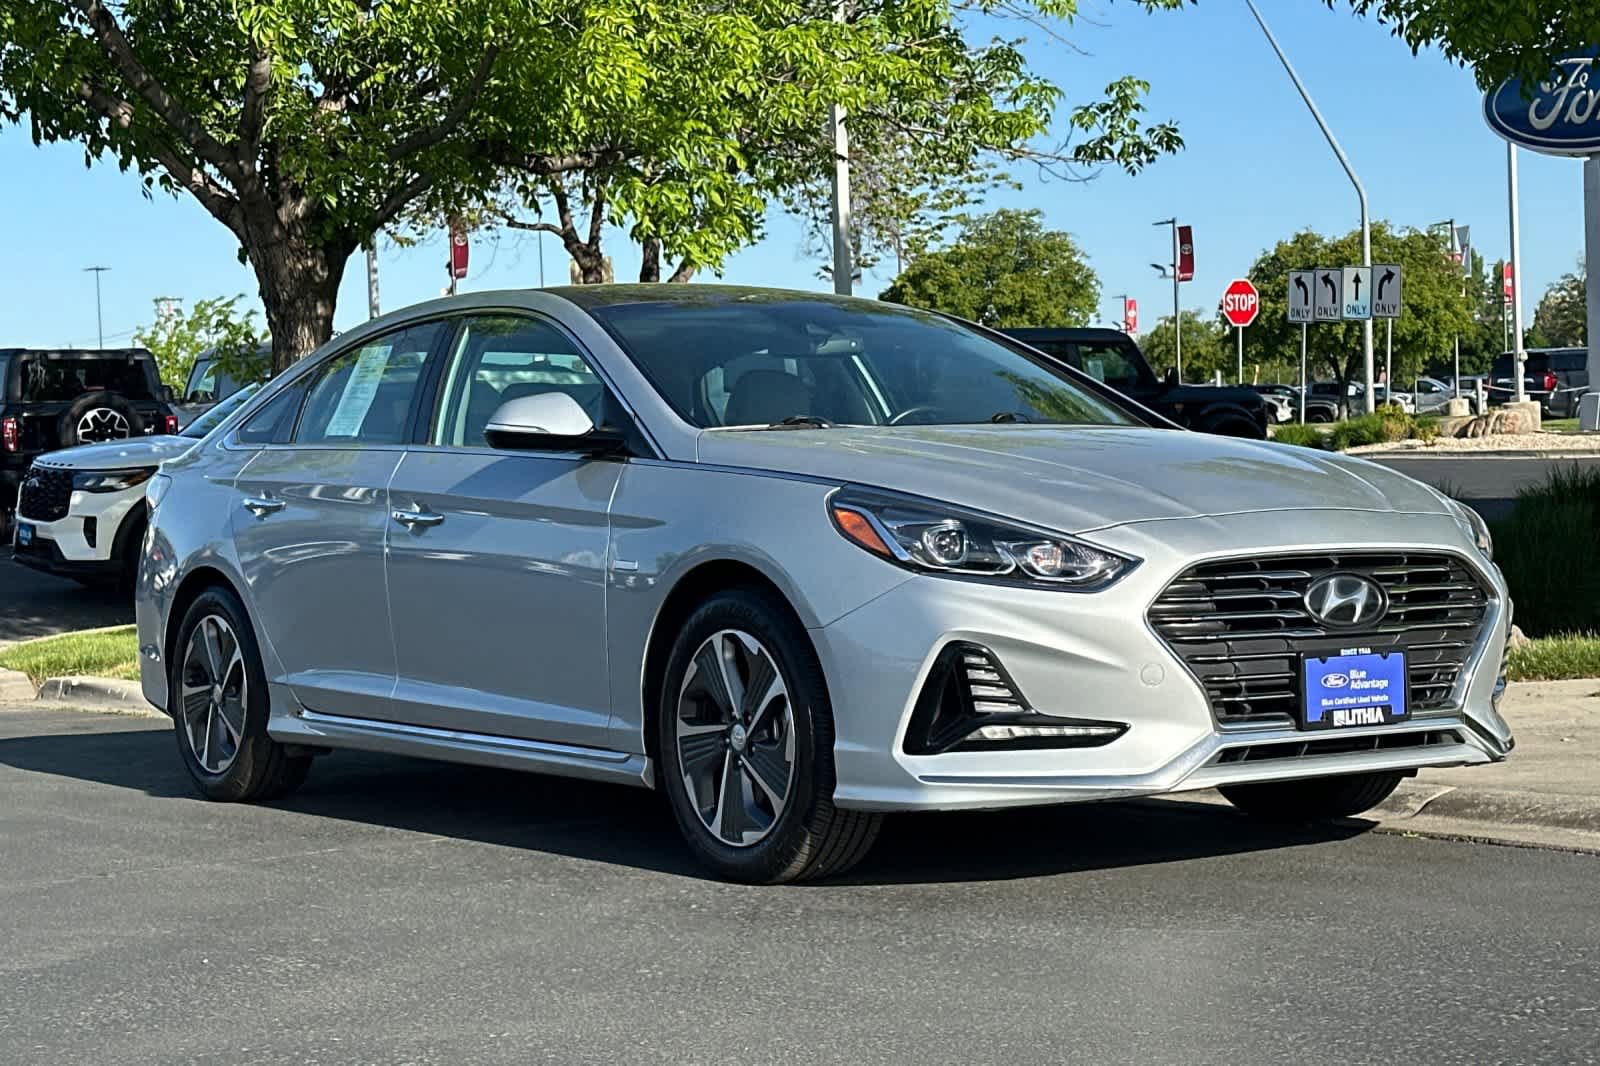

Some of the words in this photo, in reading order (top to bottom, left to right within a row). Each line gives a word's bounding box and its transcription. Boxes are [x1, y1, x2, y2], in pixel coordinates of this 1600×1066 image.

[1226, 294, 1256, 312] STOP
[1374, 303, 1397, 313] ONLY
[1290, 307, 1310, 318] ONLY
[1317, 306, 1338, 317] ONLY
[1346, 303, 1367, 315] ONLY
[1349, 669, 1367, 679] Blue
[1350, 679, 1389, 690] Advantage
[1321, 698, 1333, 706] Blue
[1334, 696, 1356, 705] Certified
[1345, 706, 1385, 726] LITHIA
